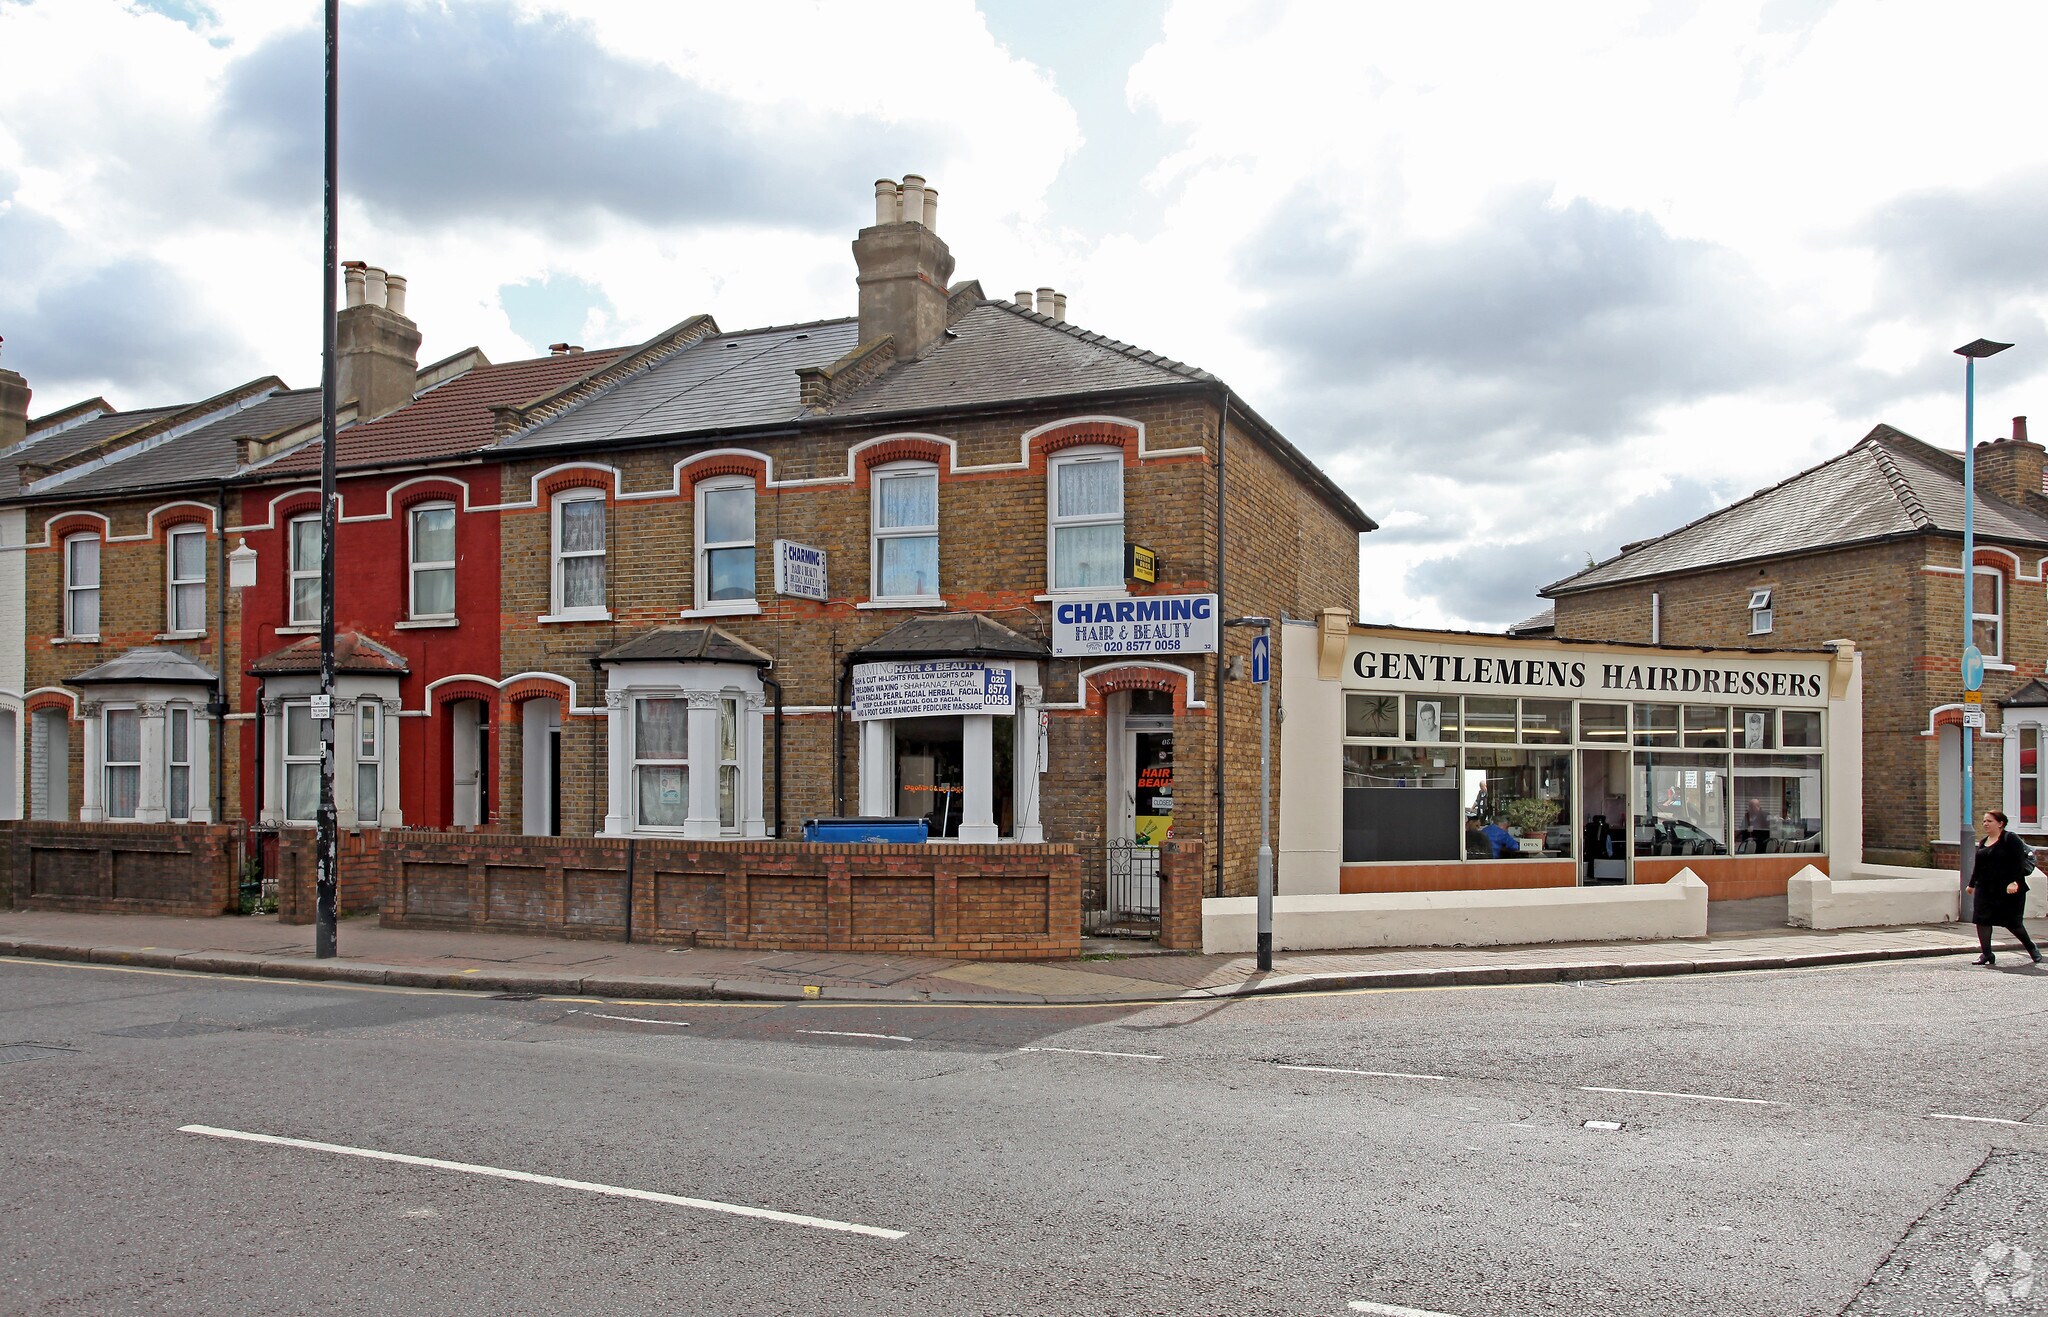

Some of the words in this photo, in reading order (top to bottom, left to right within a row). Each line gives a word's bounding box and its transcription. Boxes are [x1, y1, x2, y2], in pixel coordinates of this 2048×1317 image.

[789, 546, 820, 566] CHARMING
[1057, 599, 1211, 624] CHARMING
[1075, 625, 1114, 641] HAIR
[1118, 624, 1128, 640] &
[1133, 623, 1192, 640] BEAUTY
[1104, 641, 1123, 652] 020
[1126, 640, 1151, 652] 8577
[1155, 640, 1181, 650] 0058
[895, 664, 921, 673] HAIR
[924, 664, 933, 672] &
[936, 662, 983, 671] BEAUTY
[1353, 650, 1586, 688] GENTLEMENS
[1602, 664, 1821, 698] HAIRDRESSERS
[991, 676, 1005, 684] 020
[876, 684, 898, 692] WAXING
[988, 684, 1007, 694] 8577
[866, 693, 882, 701] FACIAL
[883, 691, 902, 699] PEARL
[904, 690, 926, 698] FACIAL
[928, 688, 954, 697] HERBAL
[985, 695, 1009, 704] 0058
[893, 705, 921, 713] MANICURE
[923, 703, 951, 712] PEDICURE
[953, 702, 982, 710] MASSAGE
[1141, 768, 1170, 777] HAIR
